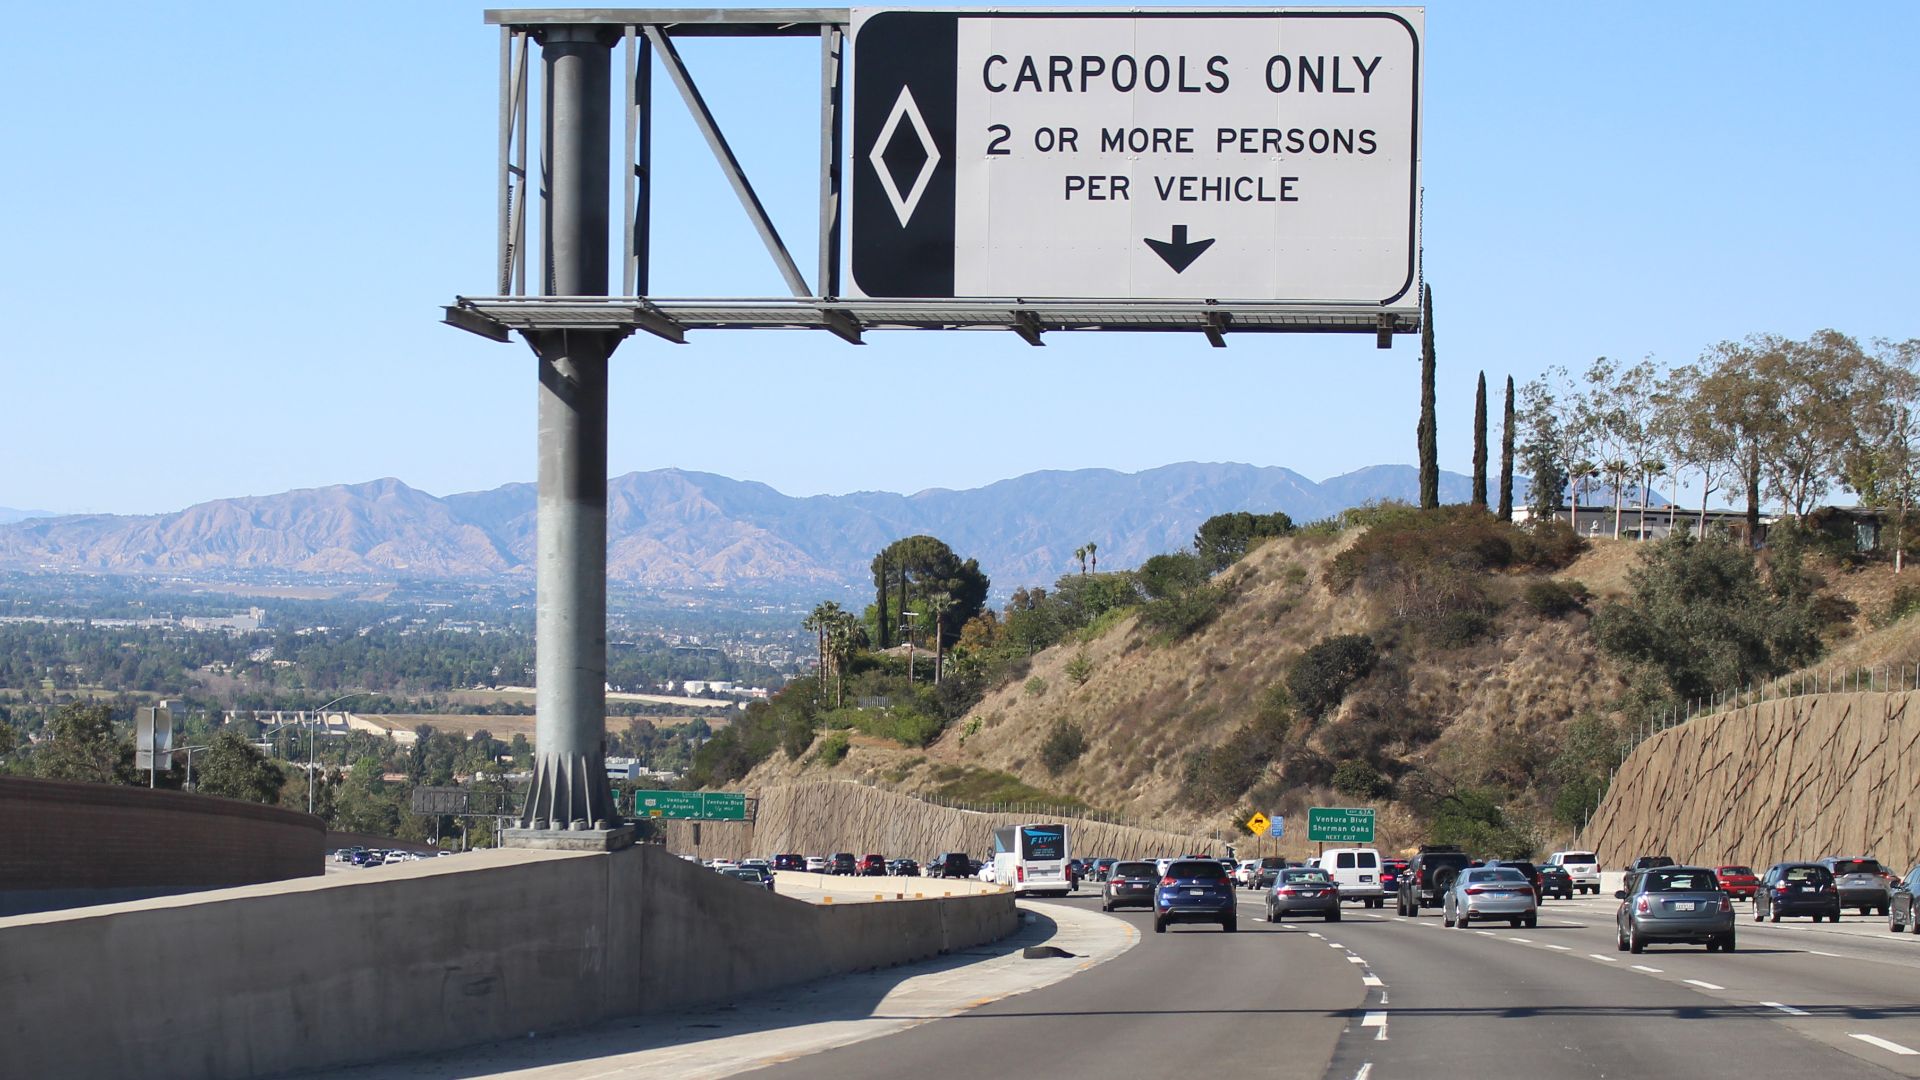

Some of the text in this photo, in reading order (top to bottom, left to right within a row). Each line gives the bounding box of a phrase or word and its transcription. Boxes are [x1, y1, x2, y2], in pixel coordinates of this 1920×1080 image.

[982, 54, 1382, 94] CARPOOLS ONLY
[986, 123, 1377, 155] 2 OR MORE PERSONS
[1065, 175, 1299, 202] PER VEHICLE
[1312, 824, 1348, 832] Sherman
[1315, 815, 1367, 823] Ventura Blvd
